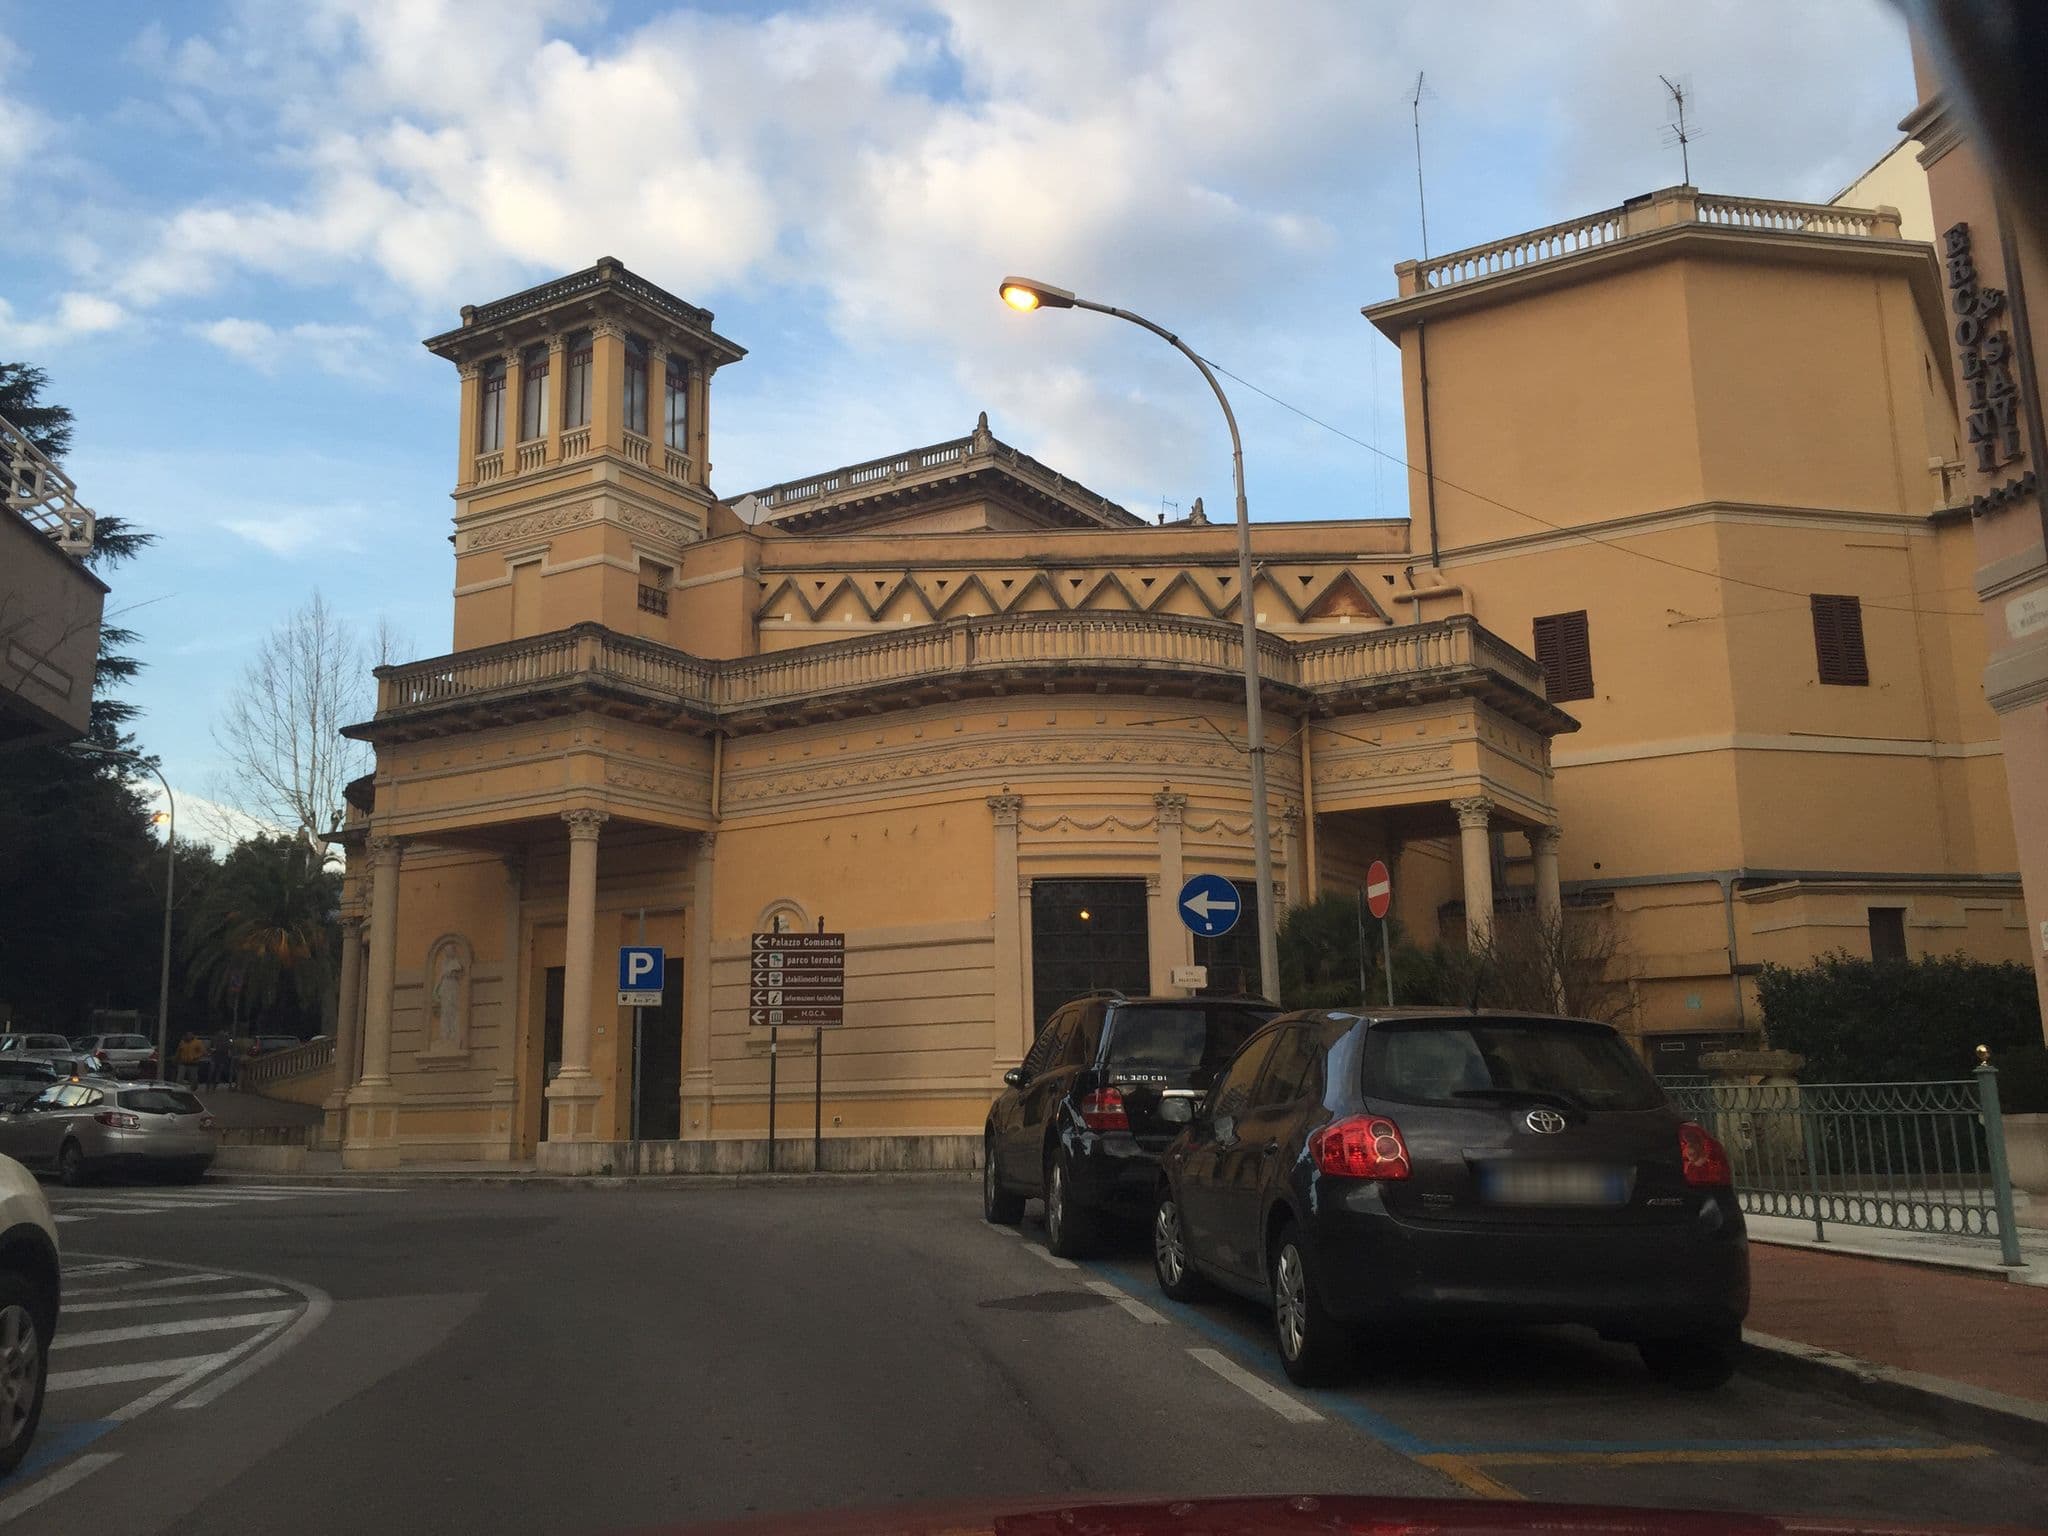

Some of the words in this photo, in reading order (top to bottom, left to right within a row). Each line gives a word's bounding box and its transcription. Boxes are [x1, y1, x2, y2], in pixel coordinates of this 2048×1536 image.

[771, 938, 801, 947] Palazzo
[803, 938, 842, 947] Comunale
[787, 957, 809, 966] parco
[811, 956, 842, 964] termale
[629, 952, 654, 985] P
